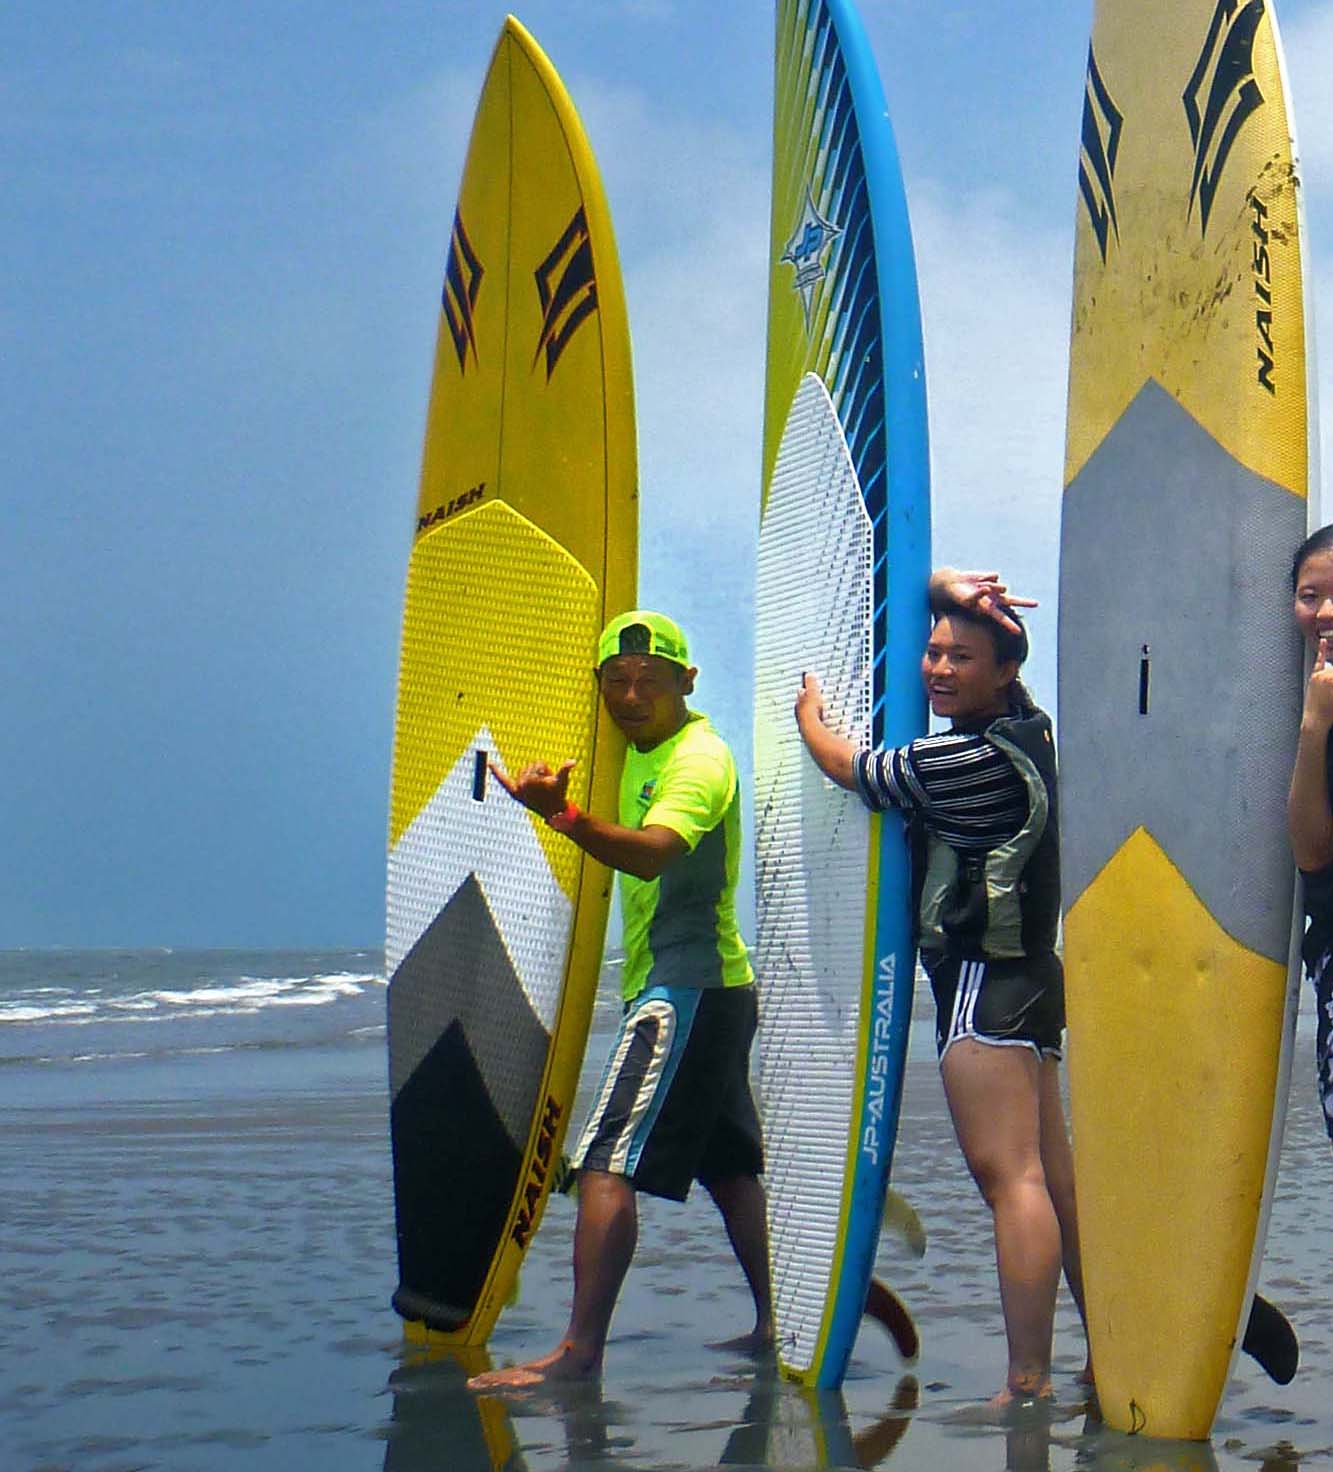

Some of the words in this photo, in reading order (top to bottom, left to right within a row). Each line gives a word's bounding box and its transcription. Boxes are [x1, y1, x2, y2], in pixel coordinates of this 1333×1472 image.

[1251, 195, 1276, 395] NAISH
[416, 482, 486, 533] NAISH
[863, 951, 897, 1166] JP-AUSTRALIA
[511, 1094, 564, 1250] NAISH
